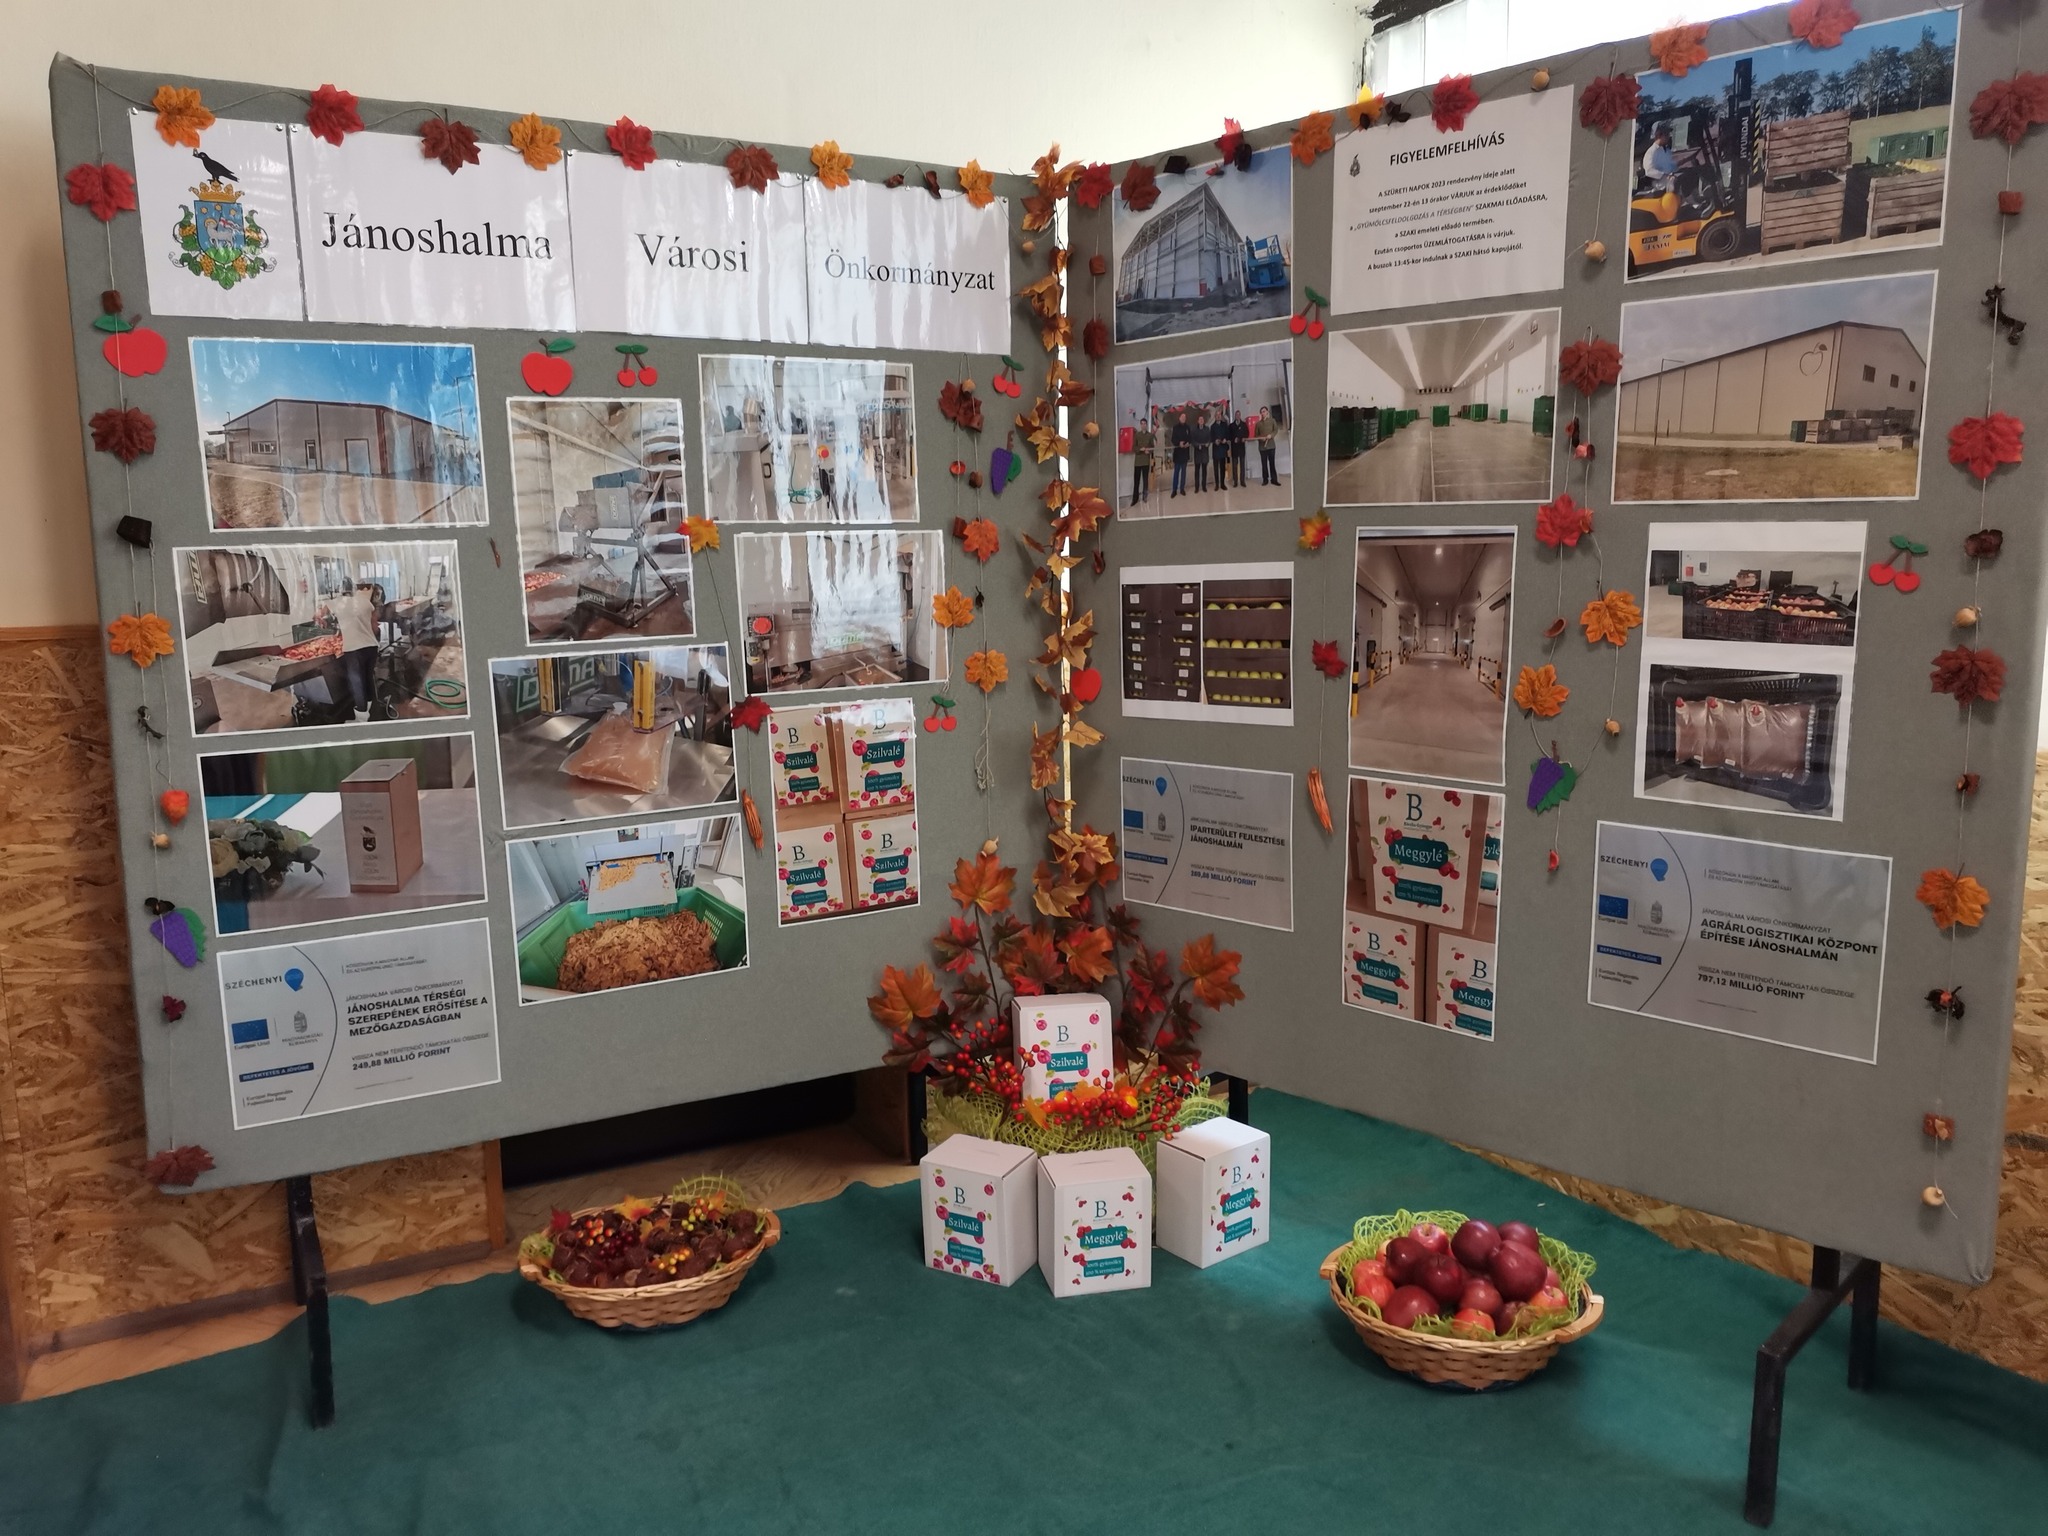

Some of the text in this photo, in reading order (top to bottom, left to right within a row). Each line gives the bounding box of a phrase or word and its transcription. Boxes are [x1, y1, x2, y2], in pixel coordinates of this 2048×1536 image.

[1390, 131, 1505, 166] FIGYELEMFELHÍVÁS
[1384, 186, 1407, 197] SZÜRETI
[1408, 183, 1430, 192] NAPOK
[1431, 180, 1446, 189] 2023
[1446, 174, 1482, 186] rendezvény
[1483, 170, 1499, 179] ideje
[1500, 168, 1515, 176] alatt
[1369, 203, 1402, 213] szeptember
[1403, 200, 1420, 208] 22-én
[1430, 194, 1450, 203] órakor
[1450, 189, 1475, 200] VÁRJUK
[1484, 182, 1527, 194] érdeklődőket
[1475, 200, 1504, 211] SZAKMAI
[1399, 229, 1417, 238] SZAKI
[1417, 225, 1440, 235] emeleti
[1440, 221, 1462, 231] előadó
[1462, 218, 1495, 228] termében.
[321, 211, 996, 293] Jánoshalma Városi Önkormányzat
[1374, 247, 1393, 256] Ezután
[1394, 243, 1422, 253] csoportos
[1493, 229, 1515, 239] várjuk.
[1373, 261, 1392, 270] buszok
[1422, 253, 1448, 263] indulnak
[1454, 250, 1472, 259] SZAKI
[873, 708, 887, 731] B
[787, 727, 799, 745] B
[866, 744, 901, 760] Szilvalé
[1405, 793, 1423, 822] B
[881, 833, 893, 849] B
[1190, 824, 1237, 839] IPARTERÜLET
[1238, 832, 1286, 846] FEJLESZTÉSE
[1190, 835, 1243, 850] JÁNOSHALMÁN
[792, 845, 806, 861] B
[1394, 844, 1443, 864] Meggylé
[1600, 855, 1649, 869] SZÉCHENYI
[874, 857, 906, 871] Szilvalé
[789, 870, 822, 883] Szilvalé
[1210, 873, 1232, 883] MILLIÓ
[1233, 877, 1257, 886] FORINT
[1746, 914, 1772, 925] VÁROSI
[1772, 917, 1831, 933] ÖNKORMÁNYZAT
[1367, 931, 1380, 951] B
[1700, 918, 1814, 945] AGRÁRLOGISZTIKAI
[1817, 936, 1878, 955] KÖZPONT
[1700, 930, 1838, 961] ÉPÍTÉSE JÁNOSHALMÁN
[1471, 958, 1487, 979] B
[1721, 969, 1736, 977] NEM
[224, 975, 283, 990] SZÉCHENYI
[1697, 974, 1805, 1000] 797,12 MILLIÓ FORINT
[347, 988, 466, 1014] JÁNOSHALMA TÉRSÉGI
[348, 1006, 421, 1026] SZEREPÉNEK
[480, 996, 489, 1004] A
[349, 1012, 462, 1037] MEZŐGAZDASÁGBAN
[1057, 1025, 1069, 1042] B
[383, 1052, 415, 1065] MILLIÓ
[417, 1046, 451, 1058] FORINT
[1050, 1055, 1084, 1068] Szilvalé
[1232, 1165, 1242, 1184] B
[954, 1186, 966, 1205] B
[1095, 1200, 1108, 1218] B
[948, 1217, 980, 1232] Szilvalé
[1084, 1230, 1124, 1245] Meggylé
